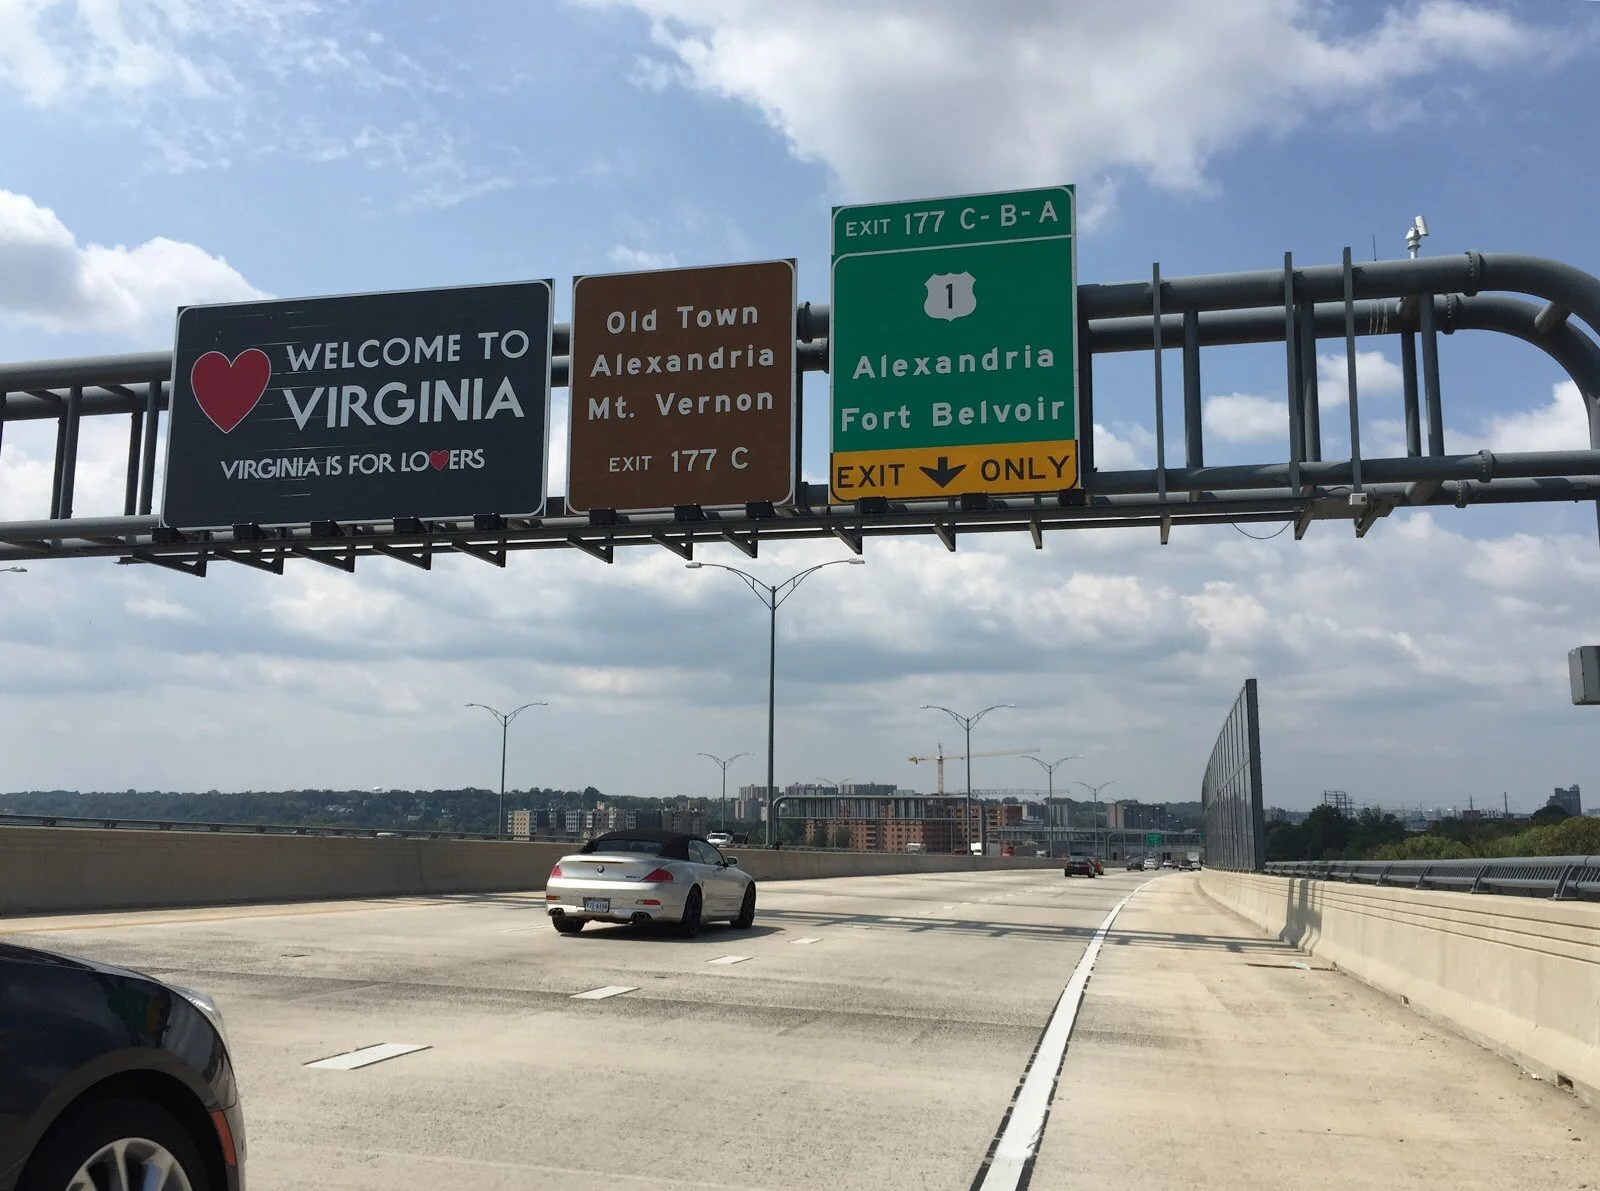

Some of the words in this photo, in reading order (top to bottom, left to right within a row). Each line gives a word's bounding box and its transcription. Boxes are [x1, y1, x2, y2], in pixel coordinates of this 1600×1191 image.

[846, 219, 890, 236] EXIT
[905, 211, 944, 234] 177
[946, 284, 953, 309] 1
[607, 309, 656, 333] Old
[677, 306, 757, 328] Town
[287, 335, 460, 371] WELCOME
[478, 330, 529, 359] TO
[590, 345, 773, 377] Alexandria
[853, 345, 1053, 379] Alexandria
[283, 376, 524, 431] VIRGINIA
[589, 396, 634, 420] Mt.
[656, 392, 772, 415] Vernon
[842, 405, 910, 431] Fort
[933, 397, 1064, 426] Belvoir
[221, 457, 320, 479] VIRGINIA
[326, 456, 342, 475] IS
[349, 454, 395, 474] FOR
[610, 456, 652, 472] EXIT
[672, 449, 717, 472] 177
[732, 447, 748, 469] C
[838, 464, 905, 488] EXIT
[981, 456, 1070, 481] ONLY
